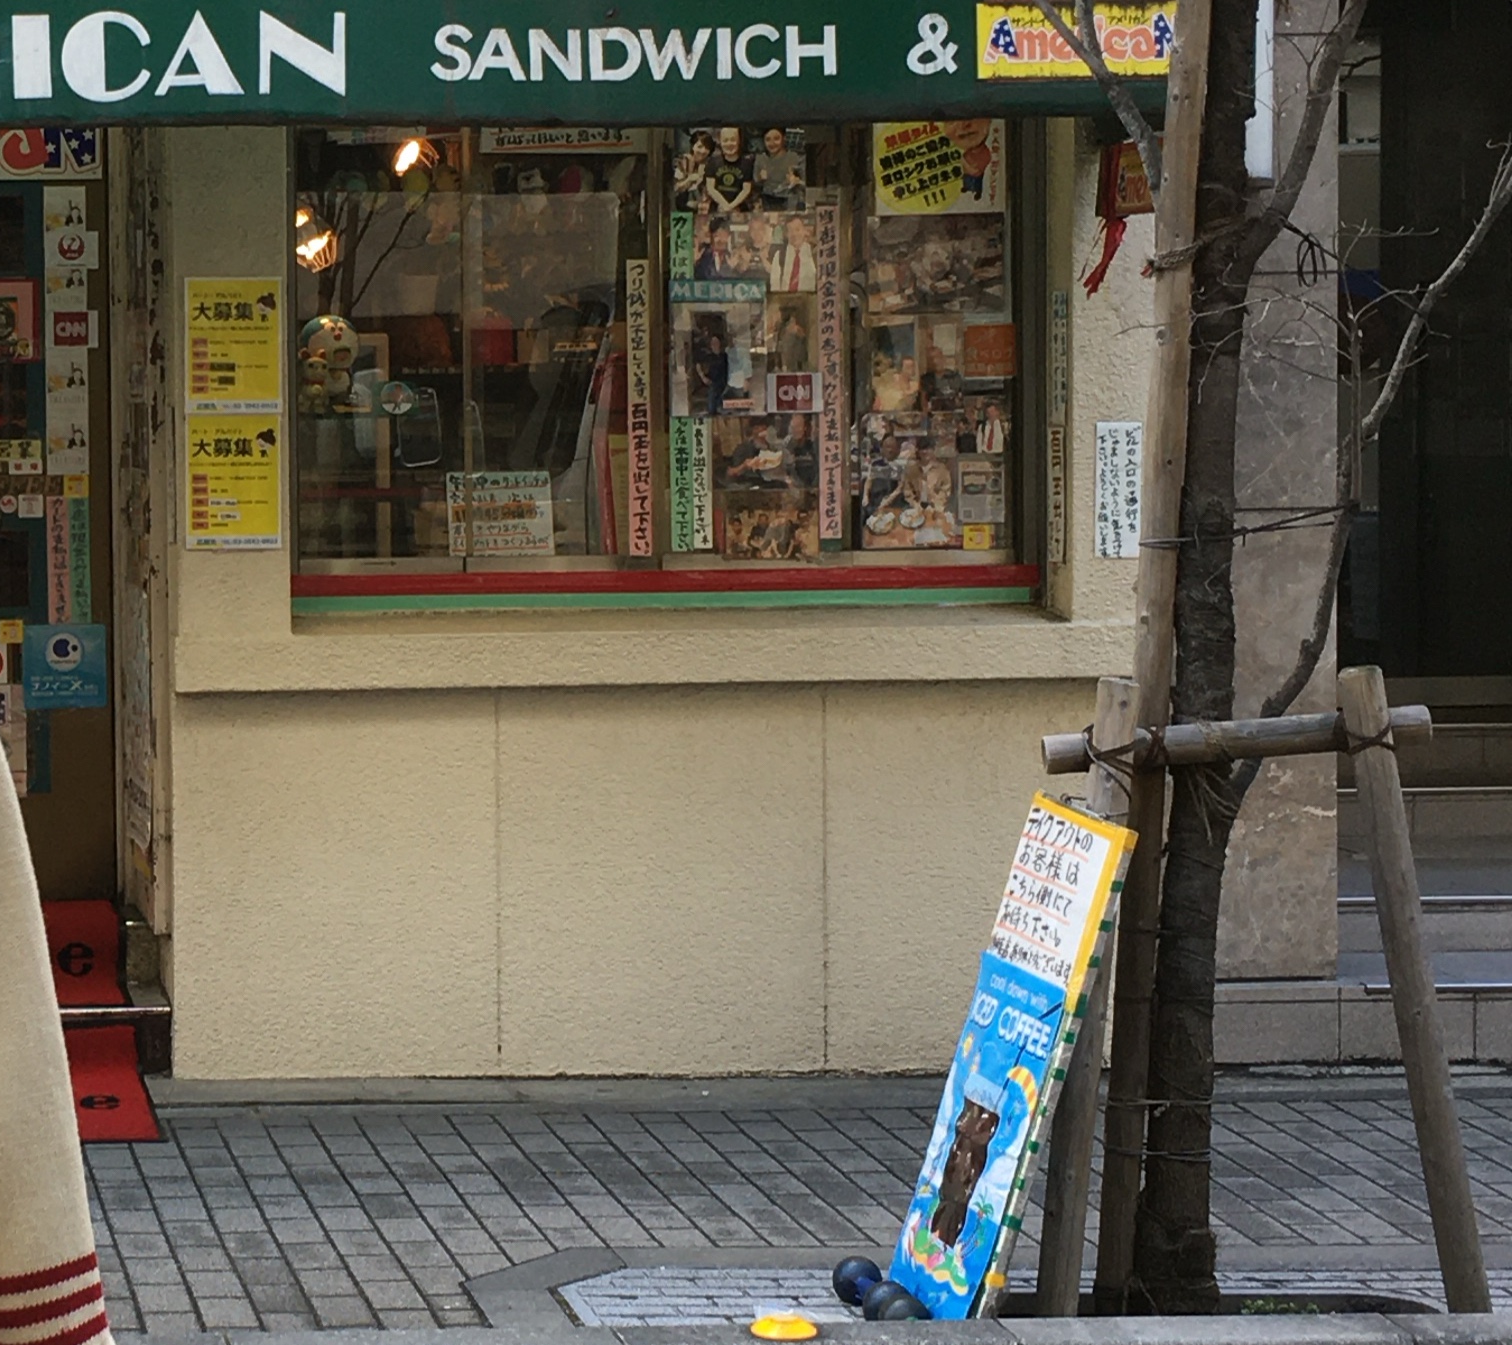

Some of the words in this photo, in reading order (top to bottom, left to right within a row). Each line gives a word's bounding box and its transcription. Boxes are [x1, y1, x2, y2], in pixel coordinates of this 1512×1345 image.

[431, 23, 837, 83] SANDWICH
[906, 13, 959, 75] &
[192, 301, 254, 322] 大募集
[55, 321, 87, 338] CNN
[778, 384, 811, 402] CNN
[192, 437, 254, 458] 大募集
[1019, 840, 1080, 886] お客様は
[990, 973, 1007, 993] cool
[1007, 979, 1029, 1005] down
[998, 1005, 1052, 1061] COFFEE
